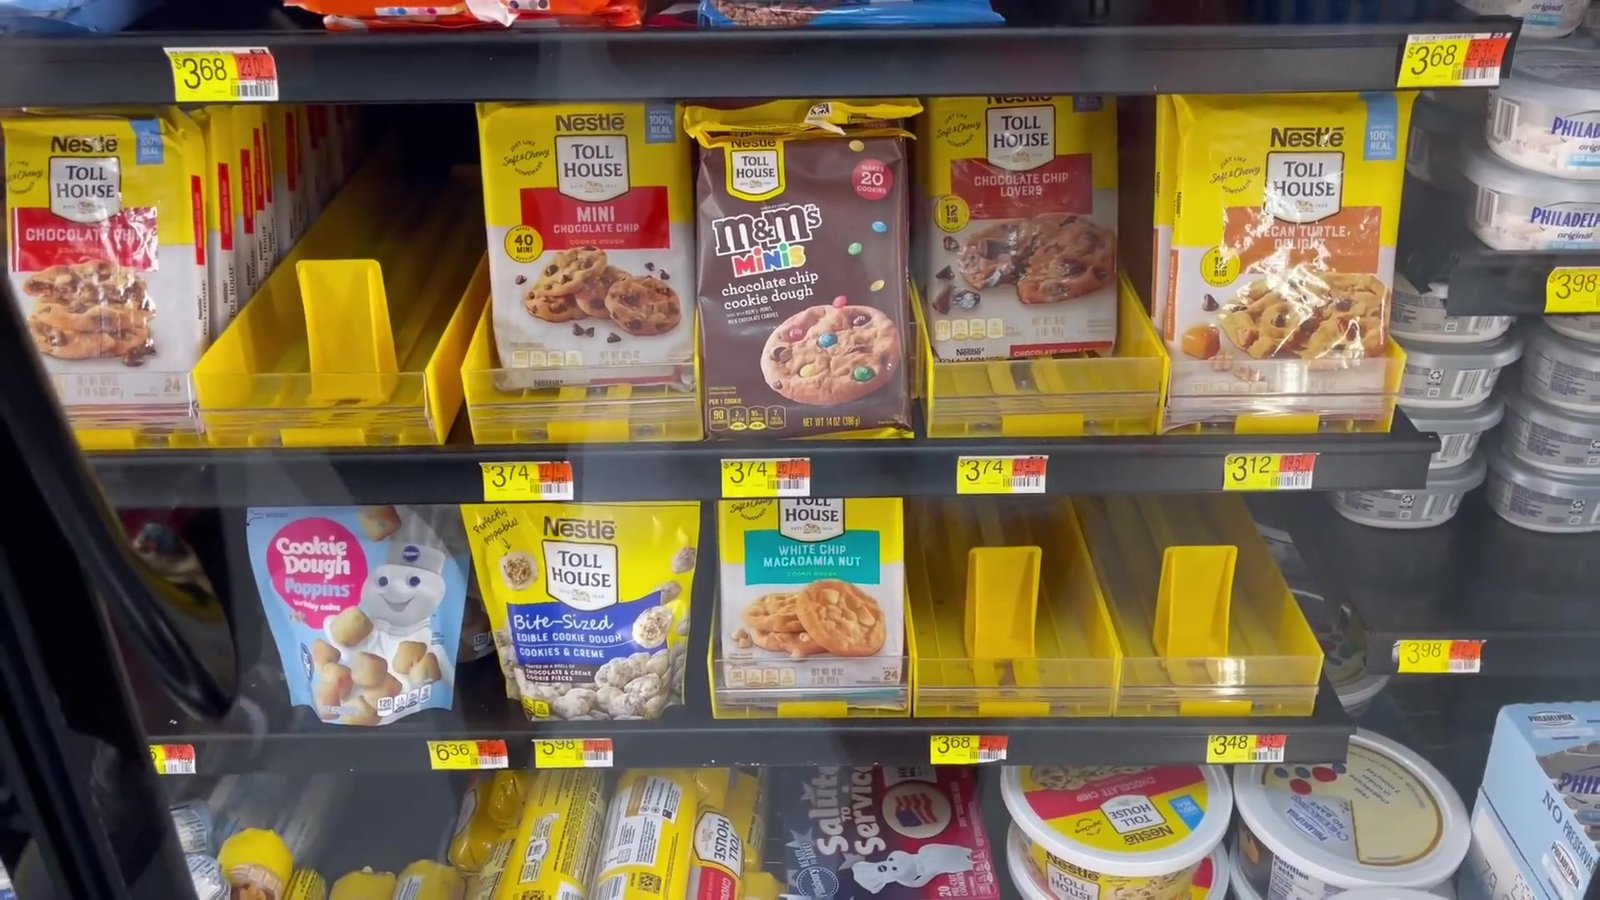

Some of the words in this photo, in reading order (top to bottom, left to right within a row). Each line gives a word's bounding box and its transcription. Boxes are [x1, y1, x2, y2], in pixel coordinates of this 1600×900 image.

[650, 114, 672, 125] 100%
[1002, 116, 1041, 130] TOLL
[651, 126, 671, 135] REAL
[1370, 130, 1395, 141] 100%
[994, 133, 1050, 149] HOUSE
[1370, 141, 1392, 150] REAL
[571, 144, 614, 160] TOLL
[741, 156, 769, 167] TOLL
[66, 165, 107, 181] TOLL
[564, 162, 623, 178] HOUSE
[736, 167, 776, 178] HOUSE
[861, 172, 884, 186] 20
[974, 174, 1039, 187] CHOCOLATE
[1043, 172, 1069, 184] CHIP
[56, 183, 115, 199] HOUSE
[857, 185, 887, 194] COOKIES
[1273, 181, 1336, 197] HOUSE
[576, 206, 615, 222] MINI
[945, 205, 958, 217] 12
[553, 224, 614, 234] CHOCOLATE
[616, 223, 640, 233] CHIP
[1557, 231, 1593, 240] original
[514, 234, 534, 246] 40
[722, 277, 786, 297] chocolate
[789, 271, 819, 284] chip
[724, 294, 768, 310] cookie
[771, 284, 814, 302] dough
[164, 379, 181, 393] 24
[713, 410, 724, 420] 90
[802, 417, 813, 427] NET
[785, 508, 839, 522] HOUSE
[276, 535, 347, 556] Cookie
[778, 544, 816, 556] WHITE
[820, 544, 846, 555] CHIP
[557, 550, 602, 569] TOLL
[763, 556, 834, 568] MACADAMIA
[838, 556, 862, 567] NUT
[282, 555, 351, 580] Dough
[551, 567, 612, 587] HOUSE
[285, 578, 350, 600] Poppins
[513, 614, 614, 630] Bite-Sized
[516, 632, 548, 642] EDIBLE
[552, 633, 586, 642] COOKIE
[589, 633, 622, 644] DOUGH
[519, 647, 560, 657] COOKIES
[563, 648, 570, 656] &
[573, 649, 605, 658] CREME
[883, 670, 898, 681] 24
[379, 698, 392, 707] 120
[1528, 714, 1576, 722] PHILADELPHIA
[1101, 776, 1156, 796] CHOCOLATE
[1075, 789, 1098, 802] CHIP
[840, 806, 852, 822] TO
[1109, 802, 1152, 819] HOUSE
[1542, 790, 1563, 824] NO
[1120, 814, 1153, 826] TOLL
[1287, 808, 1328, 842] PHILADELPHIA
[714, 818, 730, 861] HOUSE
[728, 833, 740, 862] TOLL
[794, 848, 810, 868] READY
[1551, 841, 1580, 889] PHILADELPHIA
[1274, 854, 1309, 880] Nutrition
[1274, 860, 1294, 880] Facts
[1056, 872, 1088, 893] TOLL
[938, 886, 952, 897] 20
